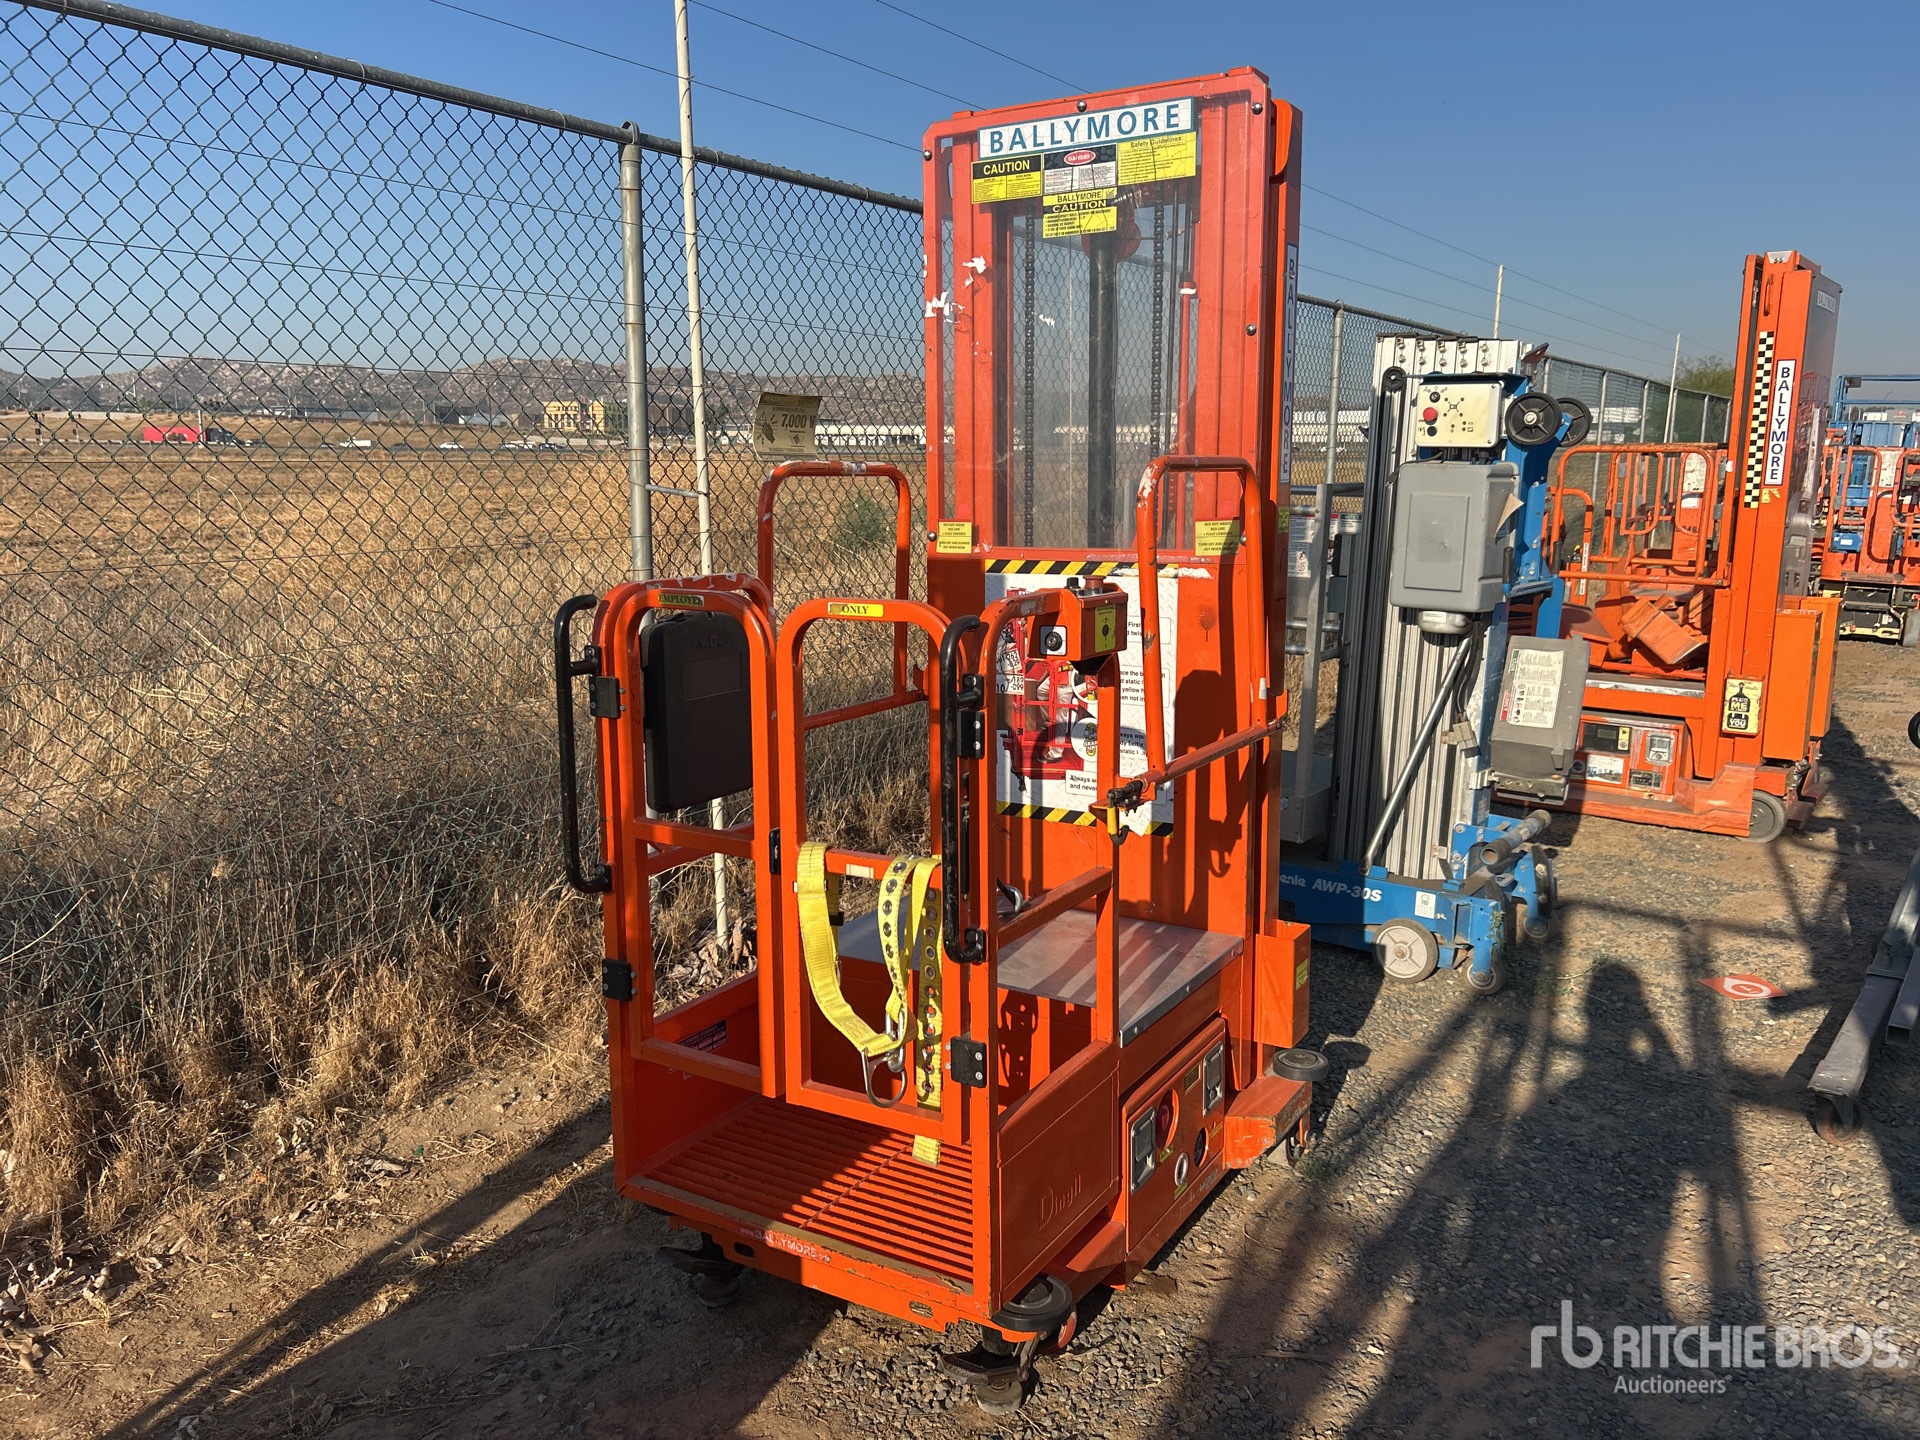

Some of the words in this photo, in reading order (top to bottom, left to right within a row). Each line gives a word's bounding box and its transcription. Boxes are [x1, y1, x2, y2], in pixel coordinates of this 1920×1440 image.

[990, 104, 1179, 154] BALLYMORE
[983, 159, 1030, 175] CAUTION
[1057, 191, 1102, 203] BALLYMORE
[1052, 200, 1107, 212] CAUTION
[1282, 258, 1295, 474] BALLYMORE
[781, 413, 808, 430] 7,000
[1770, 366, 1791, 480] BALLYMORE
[842, 604, 869, 614] ONLY
[1730, 718, 1746, 726] YOU
[1070, 775, 1094, 784] Always
[1280, 874, 1306, 887] enie
[1312, 878, 1382, 902] AWP-30S
